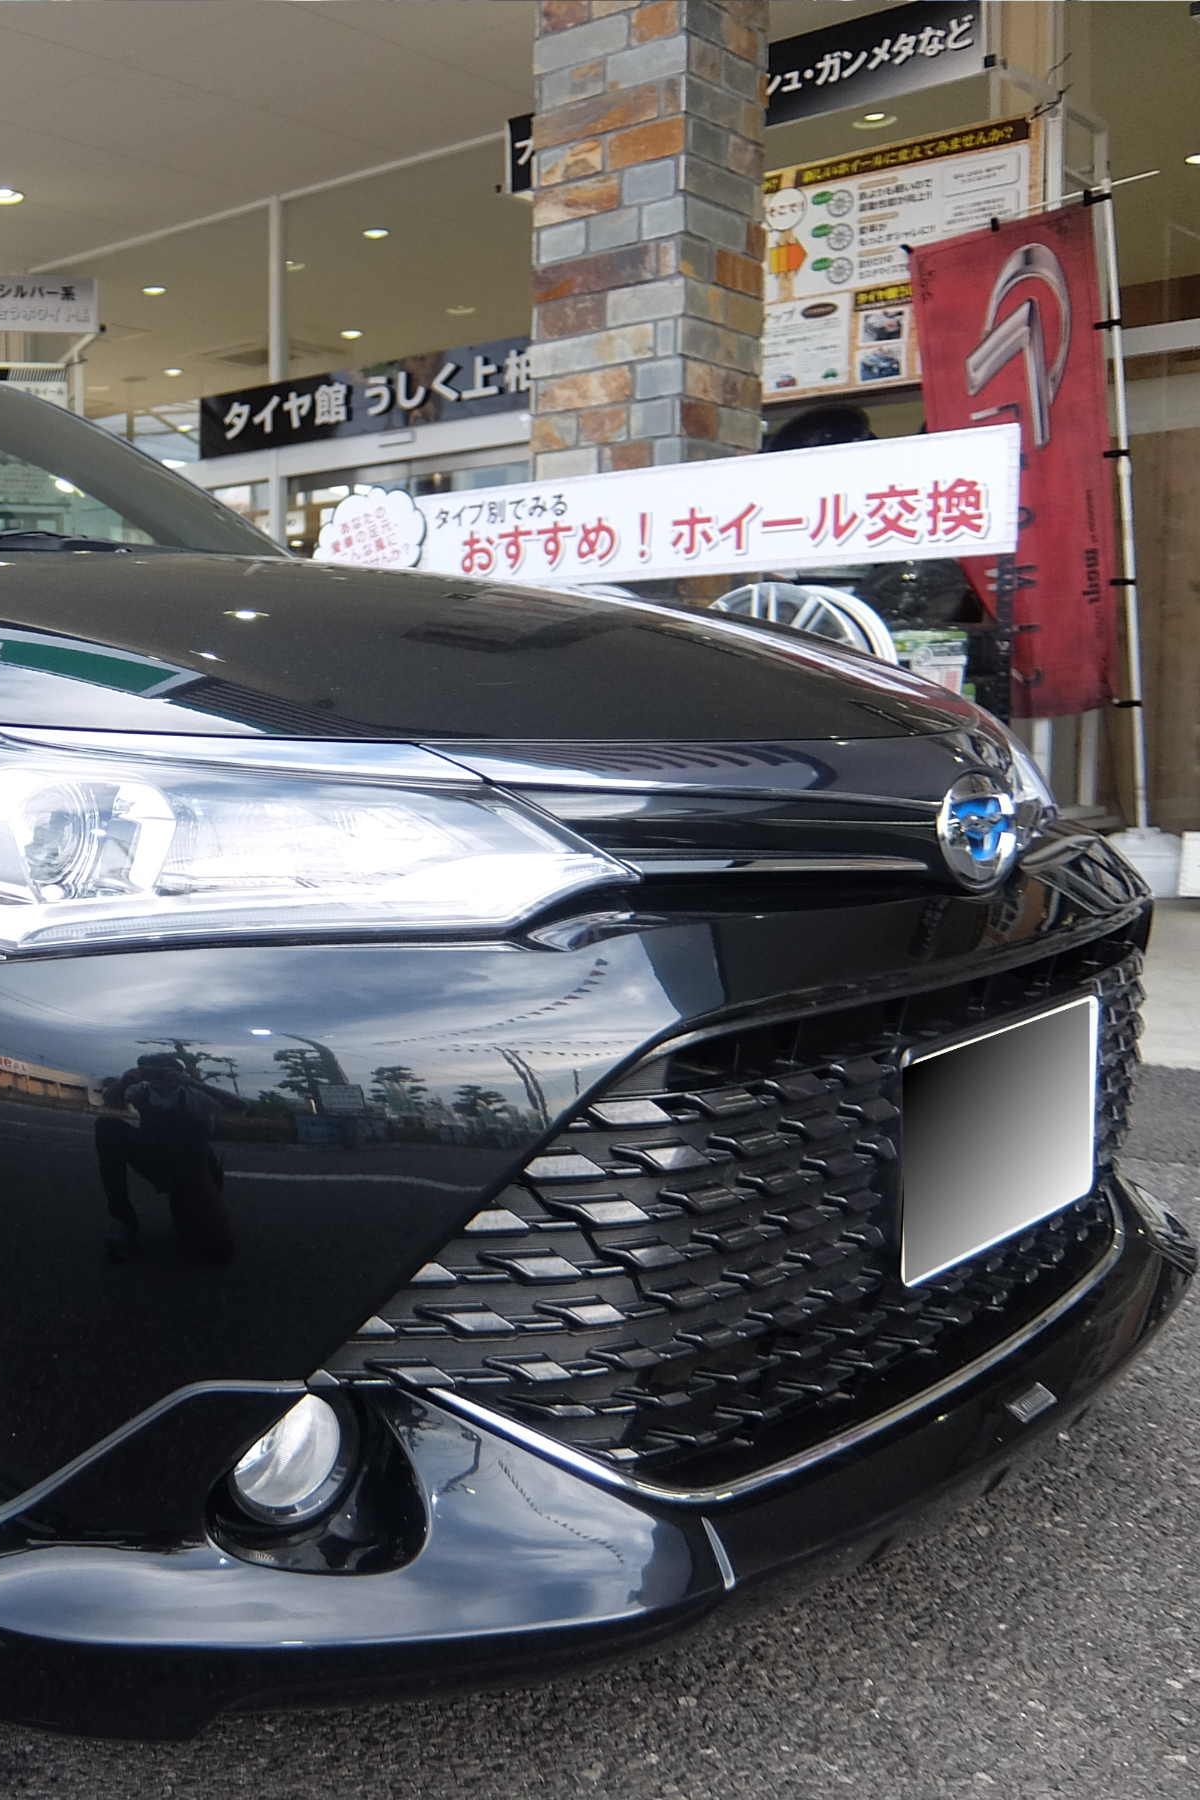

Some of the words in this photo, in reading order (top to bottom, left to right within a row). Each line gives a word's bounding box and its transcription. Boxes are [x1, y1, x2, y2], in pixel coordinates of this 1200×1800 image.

[223, 381, 348, 441] タイヤ館
[435, 493, 568, 530] タイプ別でみる
